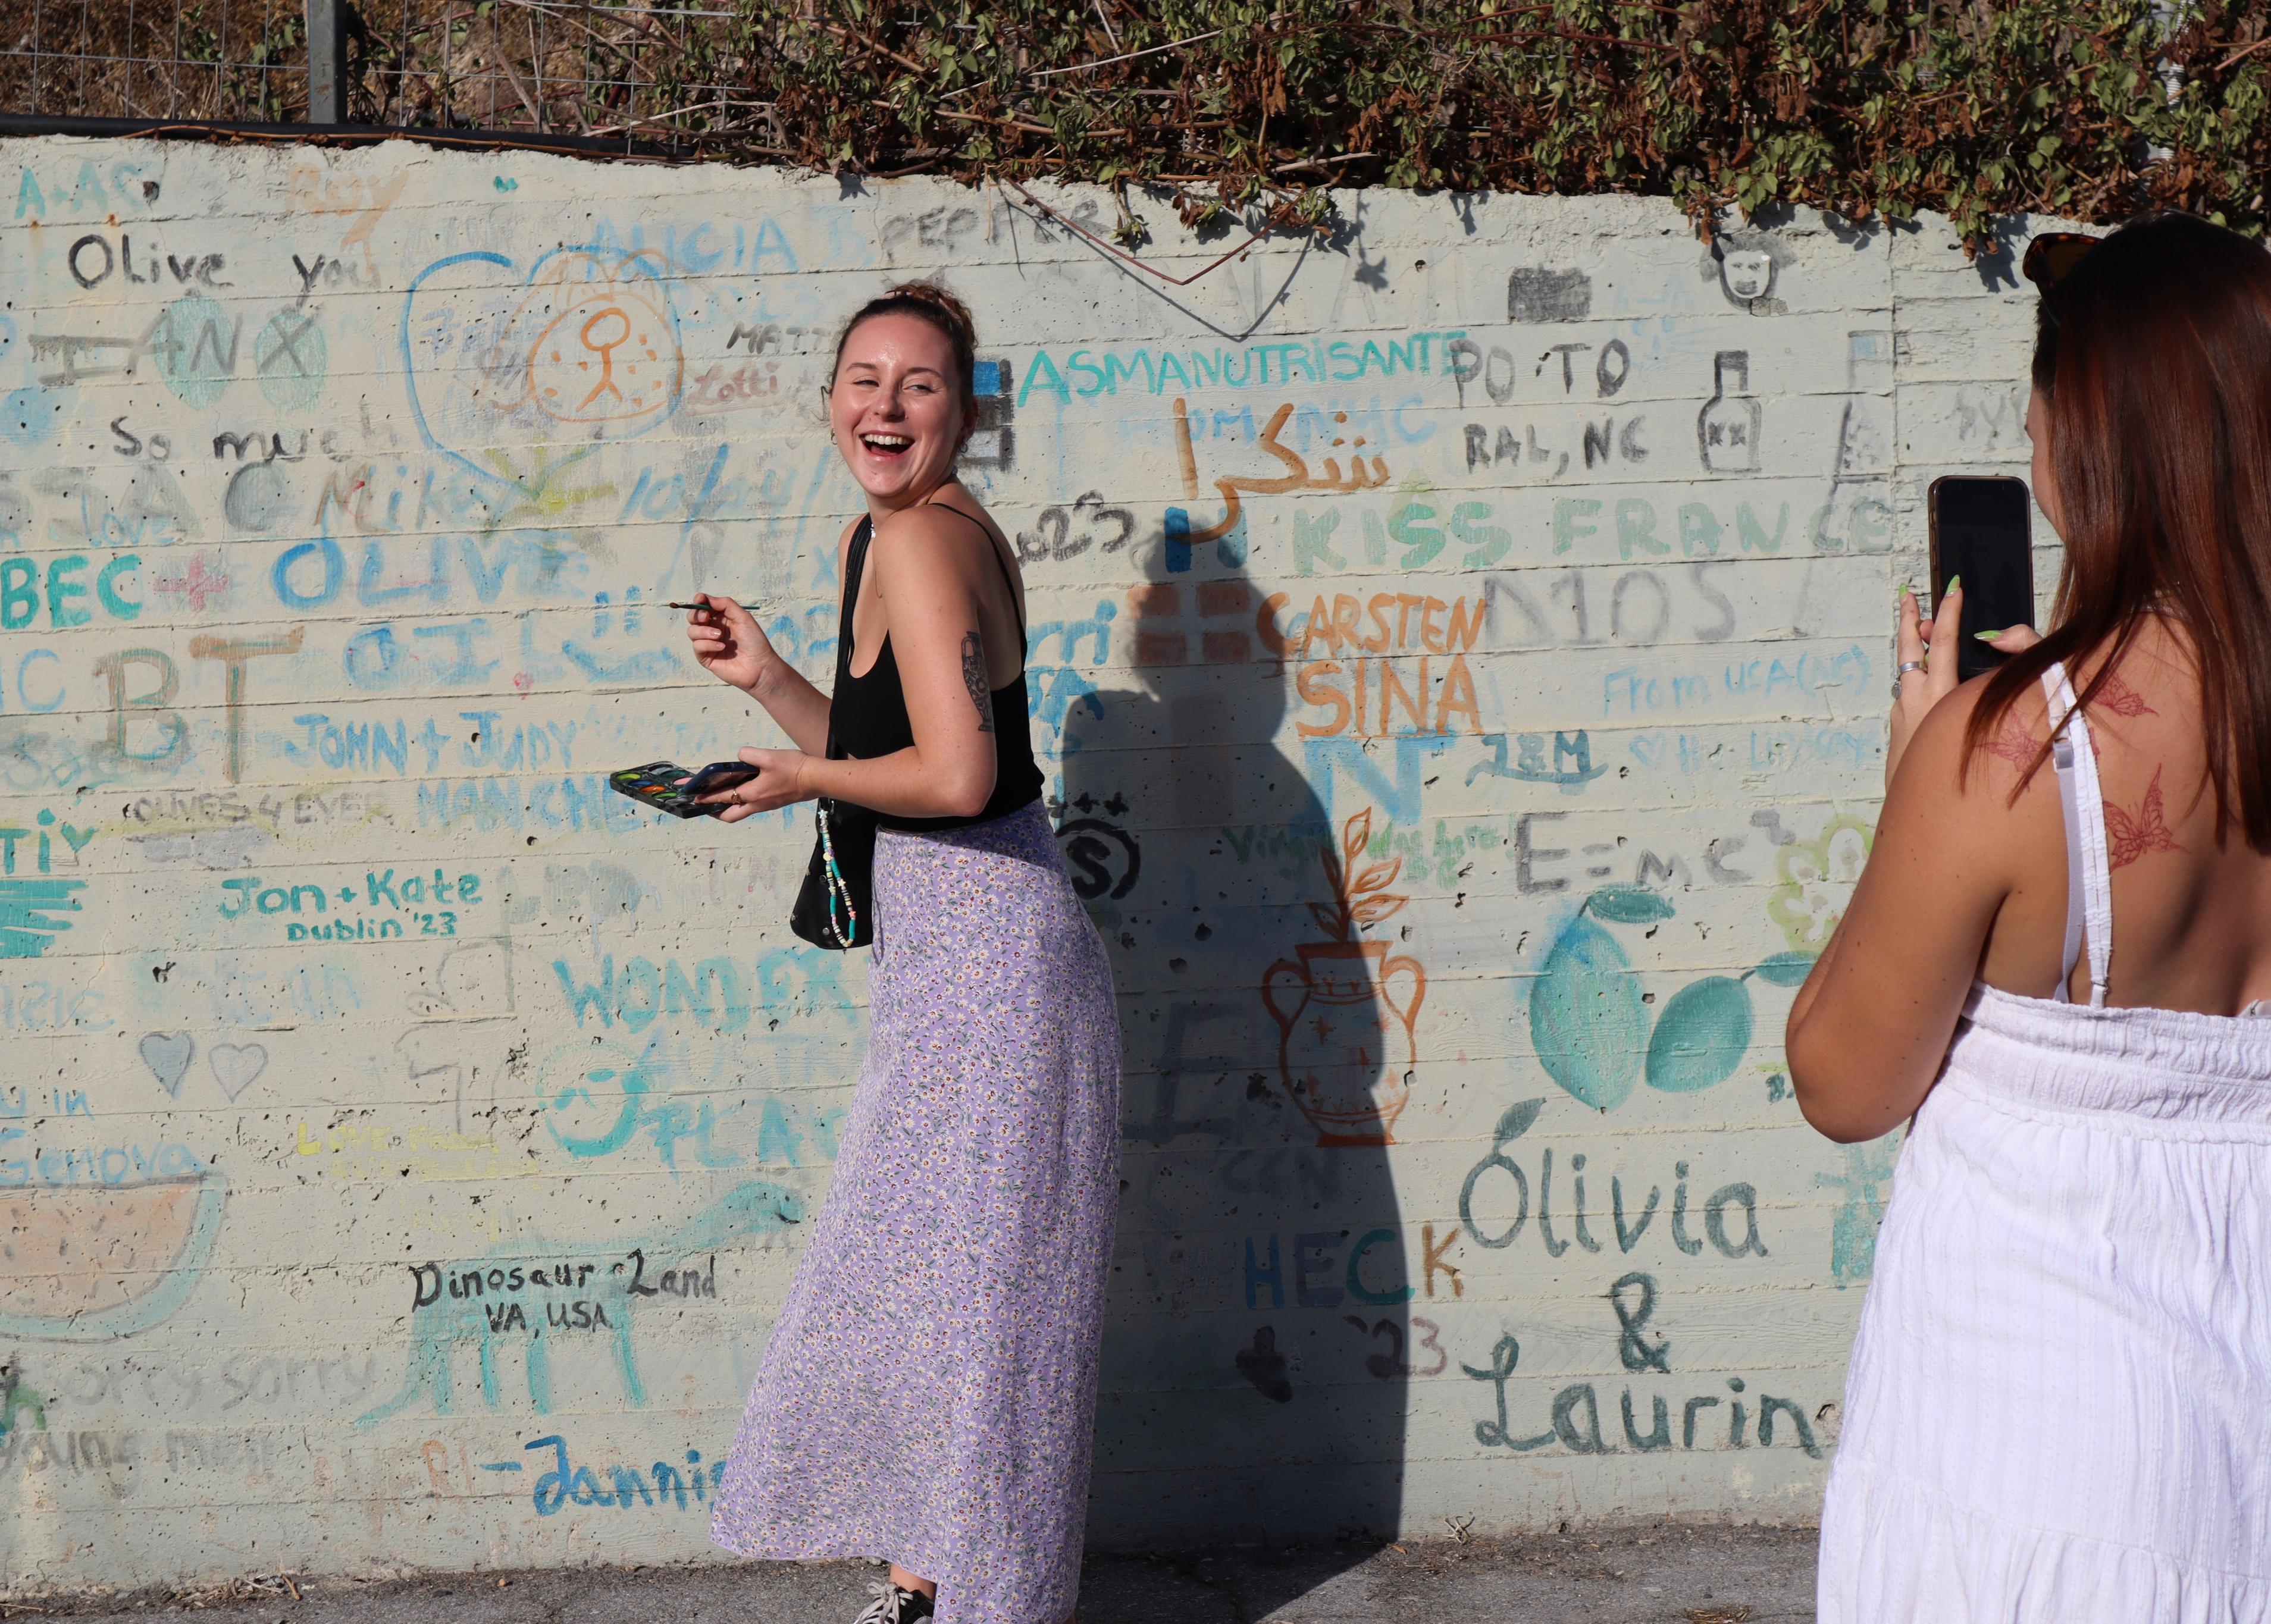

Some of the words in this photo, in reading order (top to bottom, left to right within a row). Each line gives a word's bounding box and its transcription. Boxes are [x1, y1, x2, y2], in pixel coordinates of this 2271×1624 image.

[1293, 500, 1512, 577] KISS
[1255, 590, 1486, 659] CARSTEN
[1296, 656, 1485, 739] SINA
[286, 713, 411, 776] JOHN
[218, 876, 328, 920] Jon
[365, 867, 483, 909] Kate
[1458, 1146, 1770, 1258] Olivia
[411, 1260, 595, 1312] Dinosaur
[625, 1247, 718, 1300] Land
[1243, 1222, 1465, 1309] HECK
[1610, 1271, 1673, 1374] &
